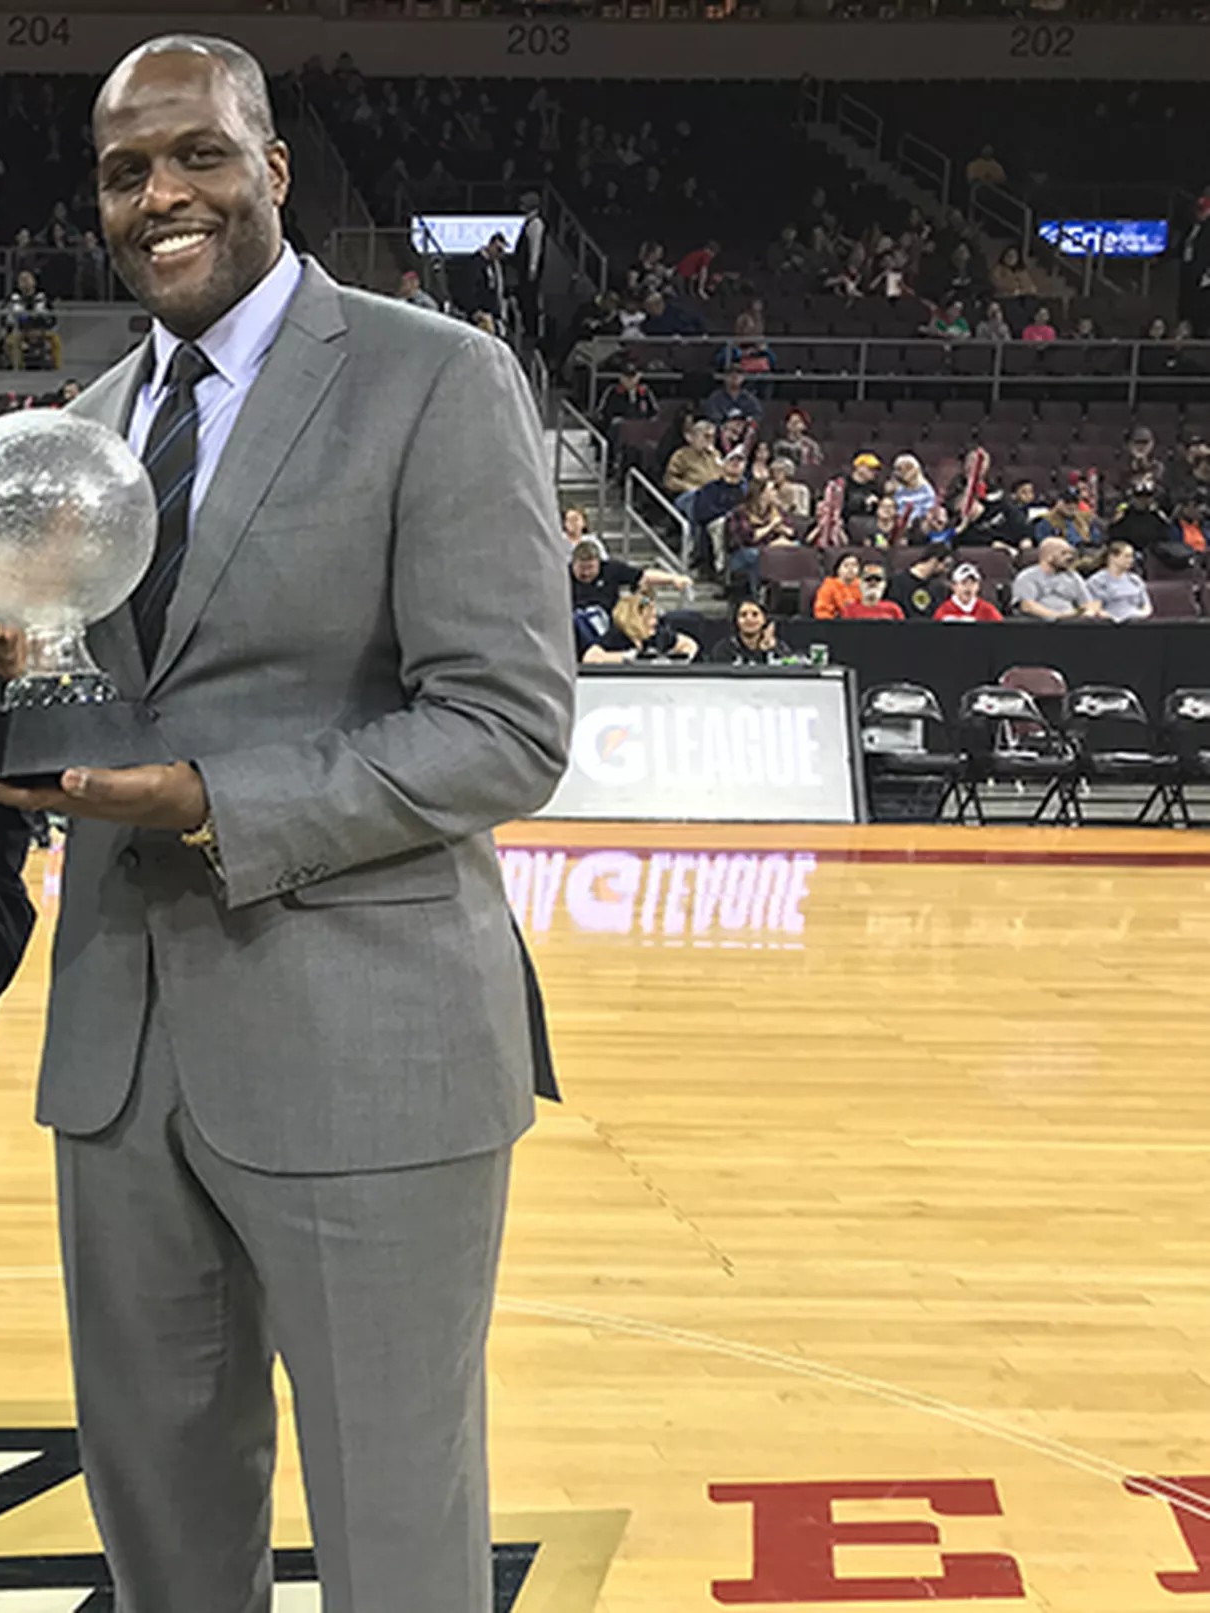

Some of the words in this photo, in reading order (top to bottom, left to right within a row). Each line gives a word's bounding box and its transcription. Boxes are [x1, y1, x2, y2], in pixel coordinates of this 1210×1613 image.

[7, 15, 71, 46] 204
[507, 23, 571, 55] 203
[1009, 25, 1075, 57] 202
[573, 705, 646, 785] G
[651, 704, 824, 787] LEAGUE
